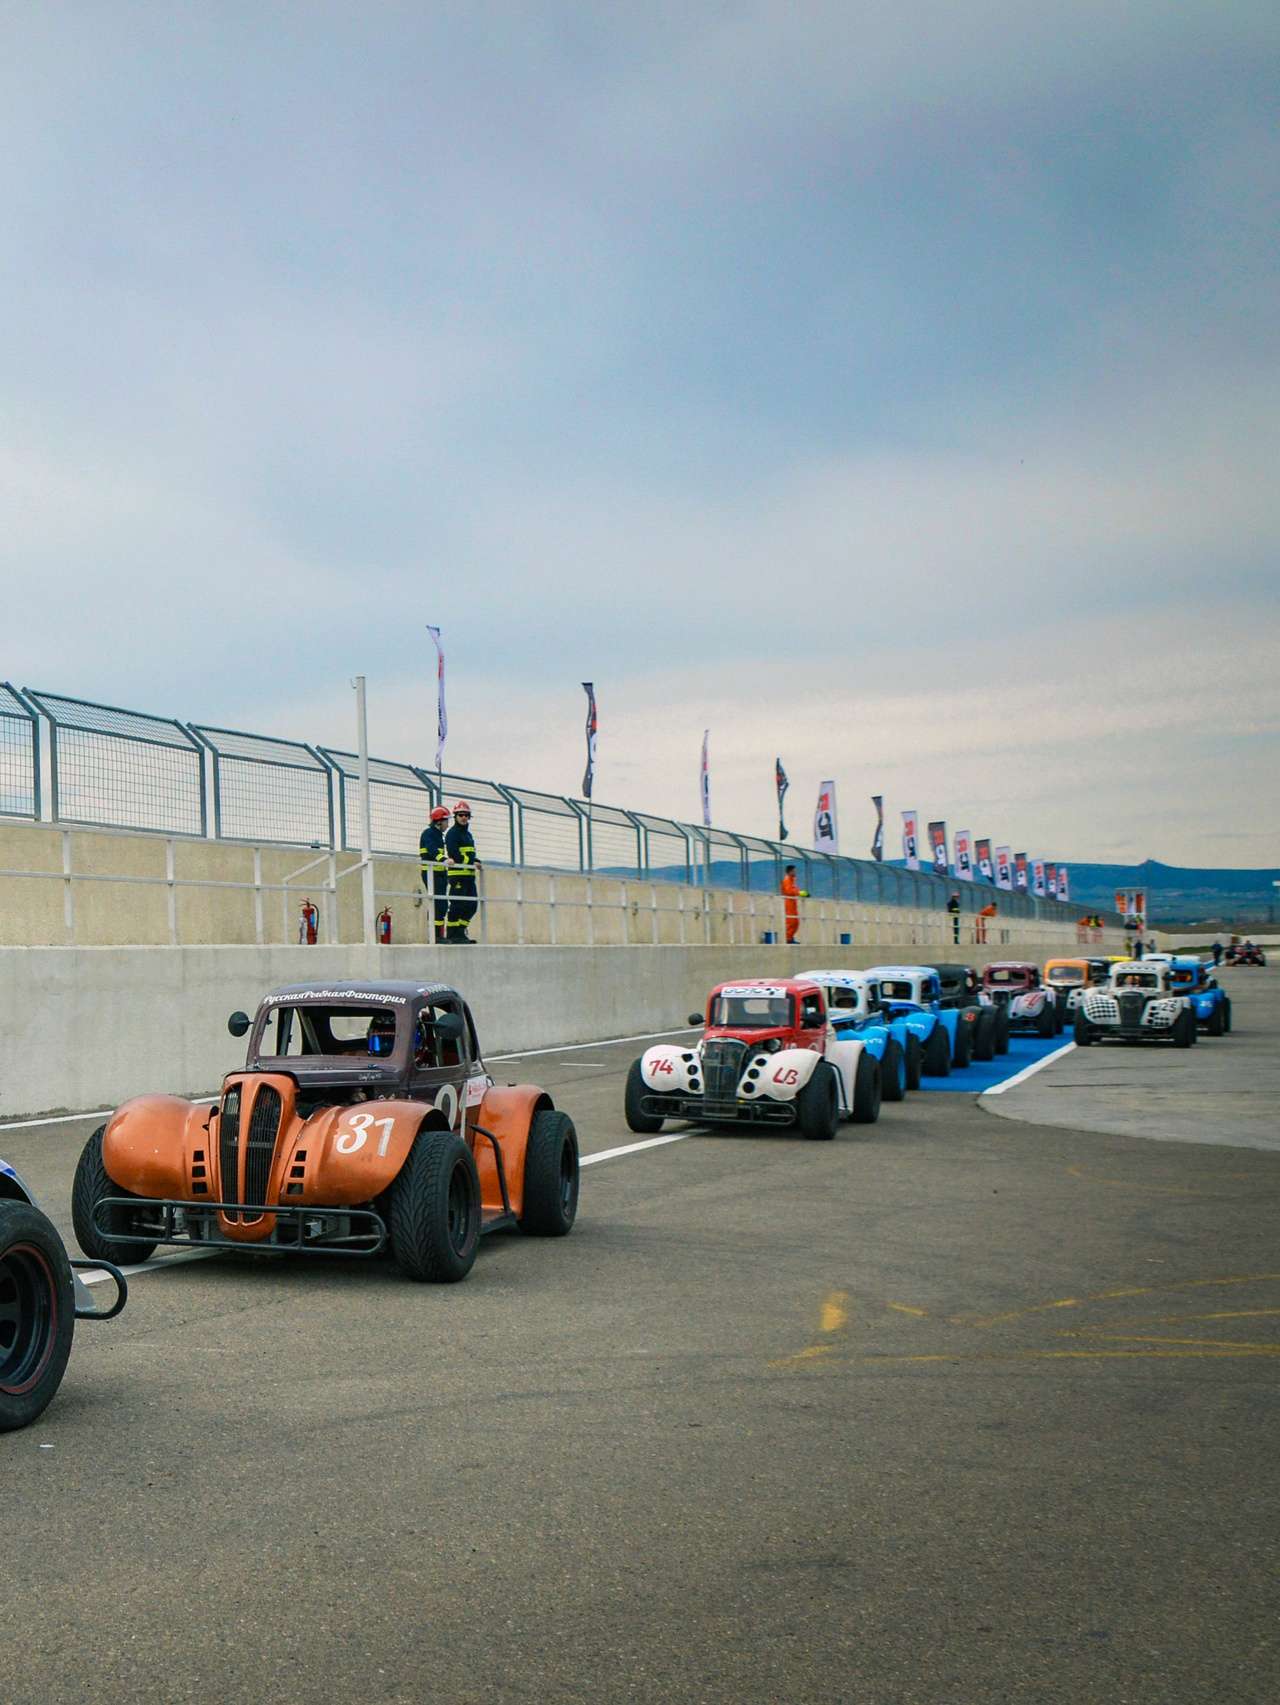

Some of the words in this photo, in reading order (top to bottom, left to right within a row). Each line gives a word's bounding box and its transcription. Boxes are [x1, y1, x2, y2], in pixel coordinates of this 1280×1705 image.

[649, 1059, 674, 1077] 74
[773, 1067, 799, 1085] LB
[336, 1114, 395, 1157] 31
